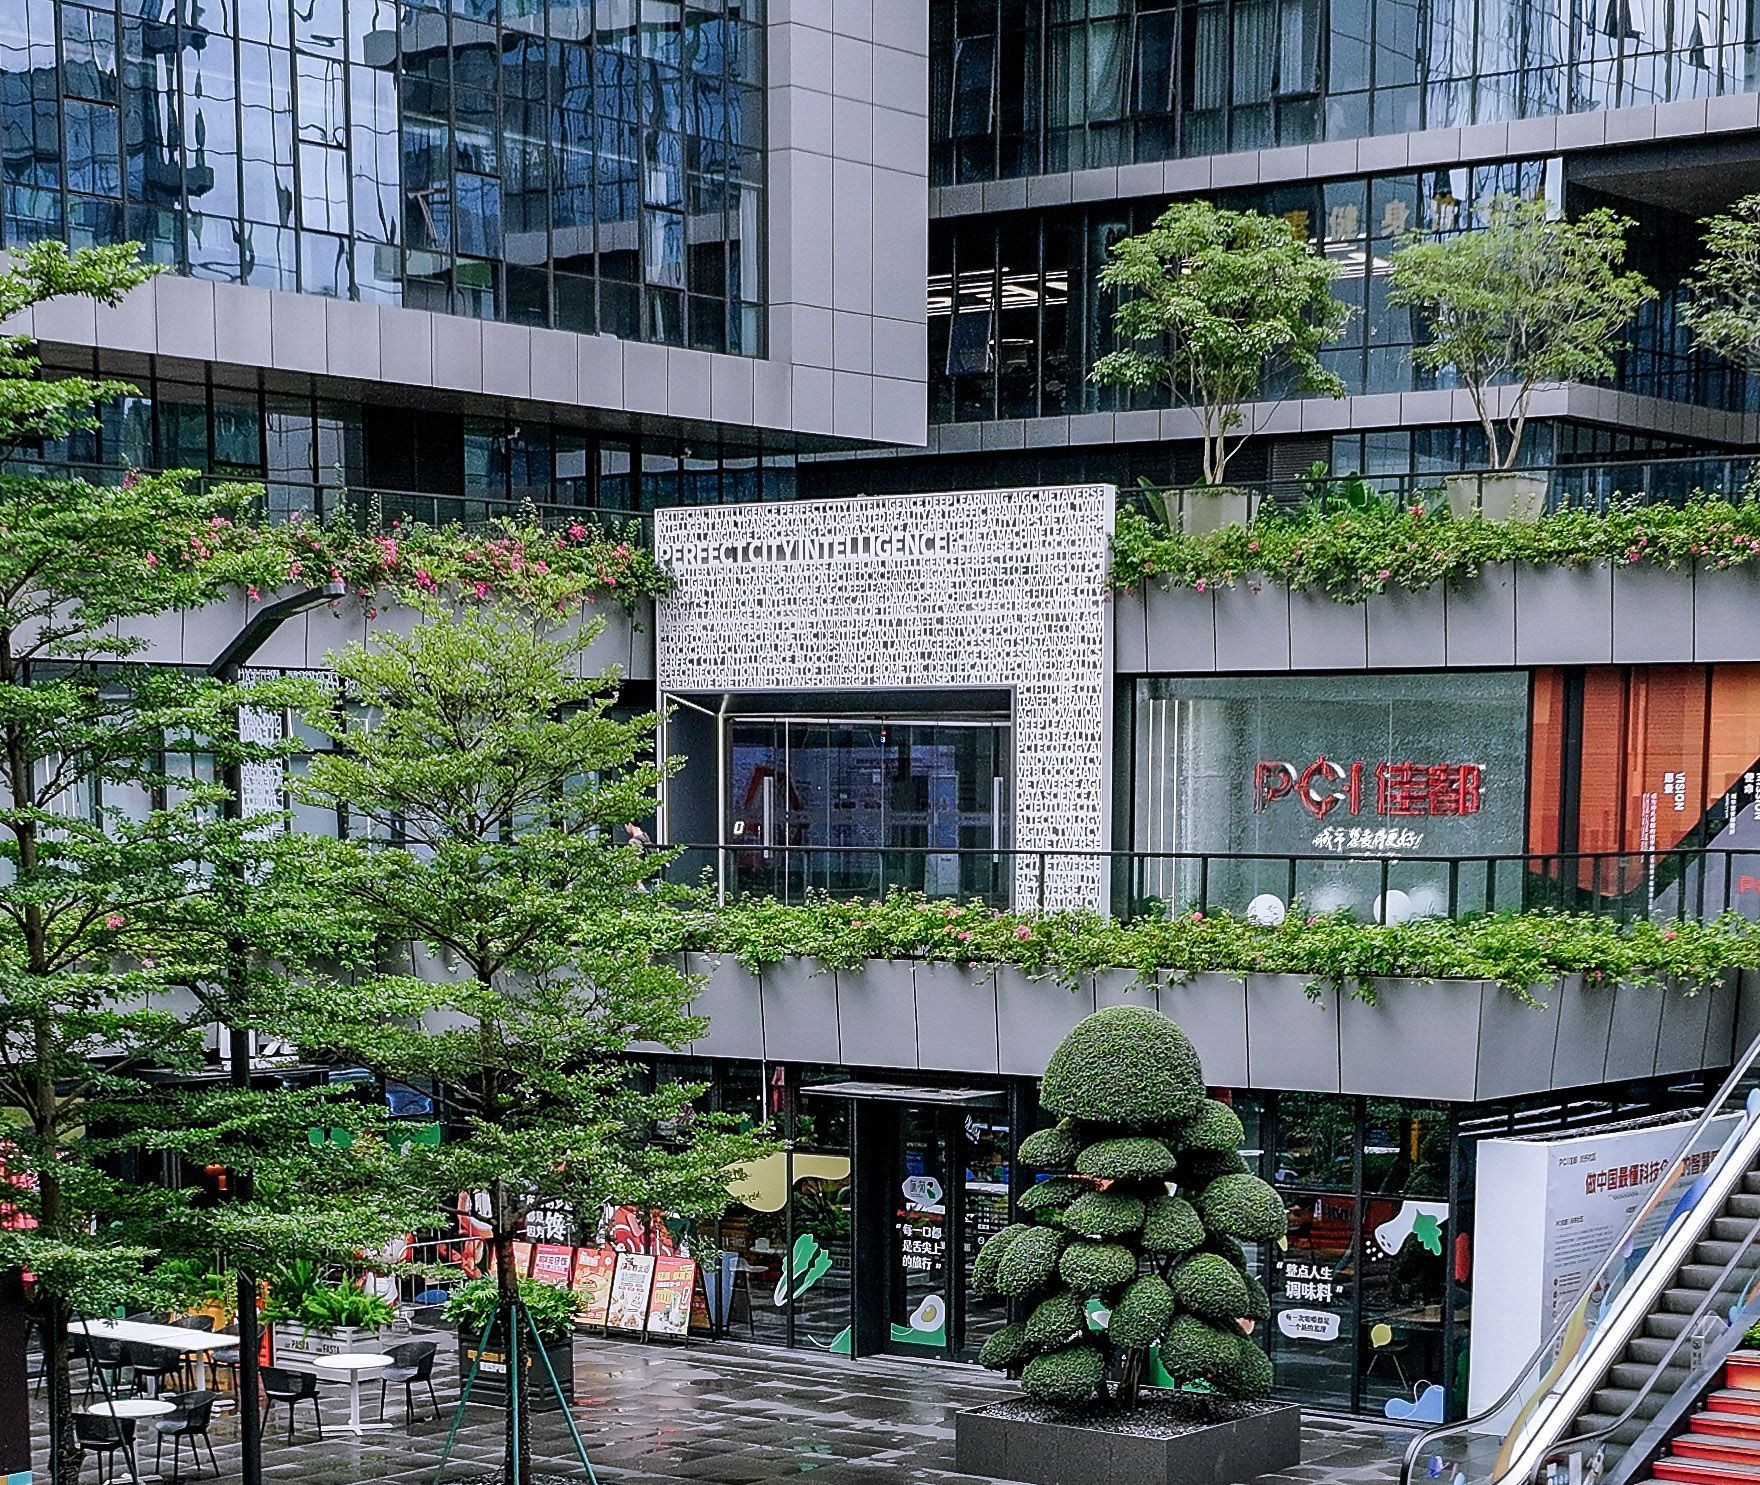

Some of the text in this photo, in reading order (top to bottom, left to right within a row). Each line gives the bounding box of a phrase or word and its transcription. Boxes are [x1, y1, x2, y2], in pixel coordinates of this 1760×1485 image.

[658, 531, 947, 566] PERFECT CITY INTELLIGENCE
[1252, 755, 1364, 821] PCI
[1673, 771, 1686, 811] VISION
